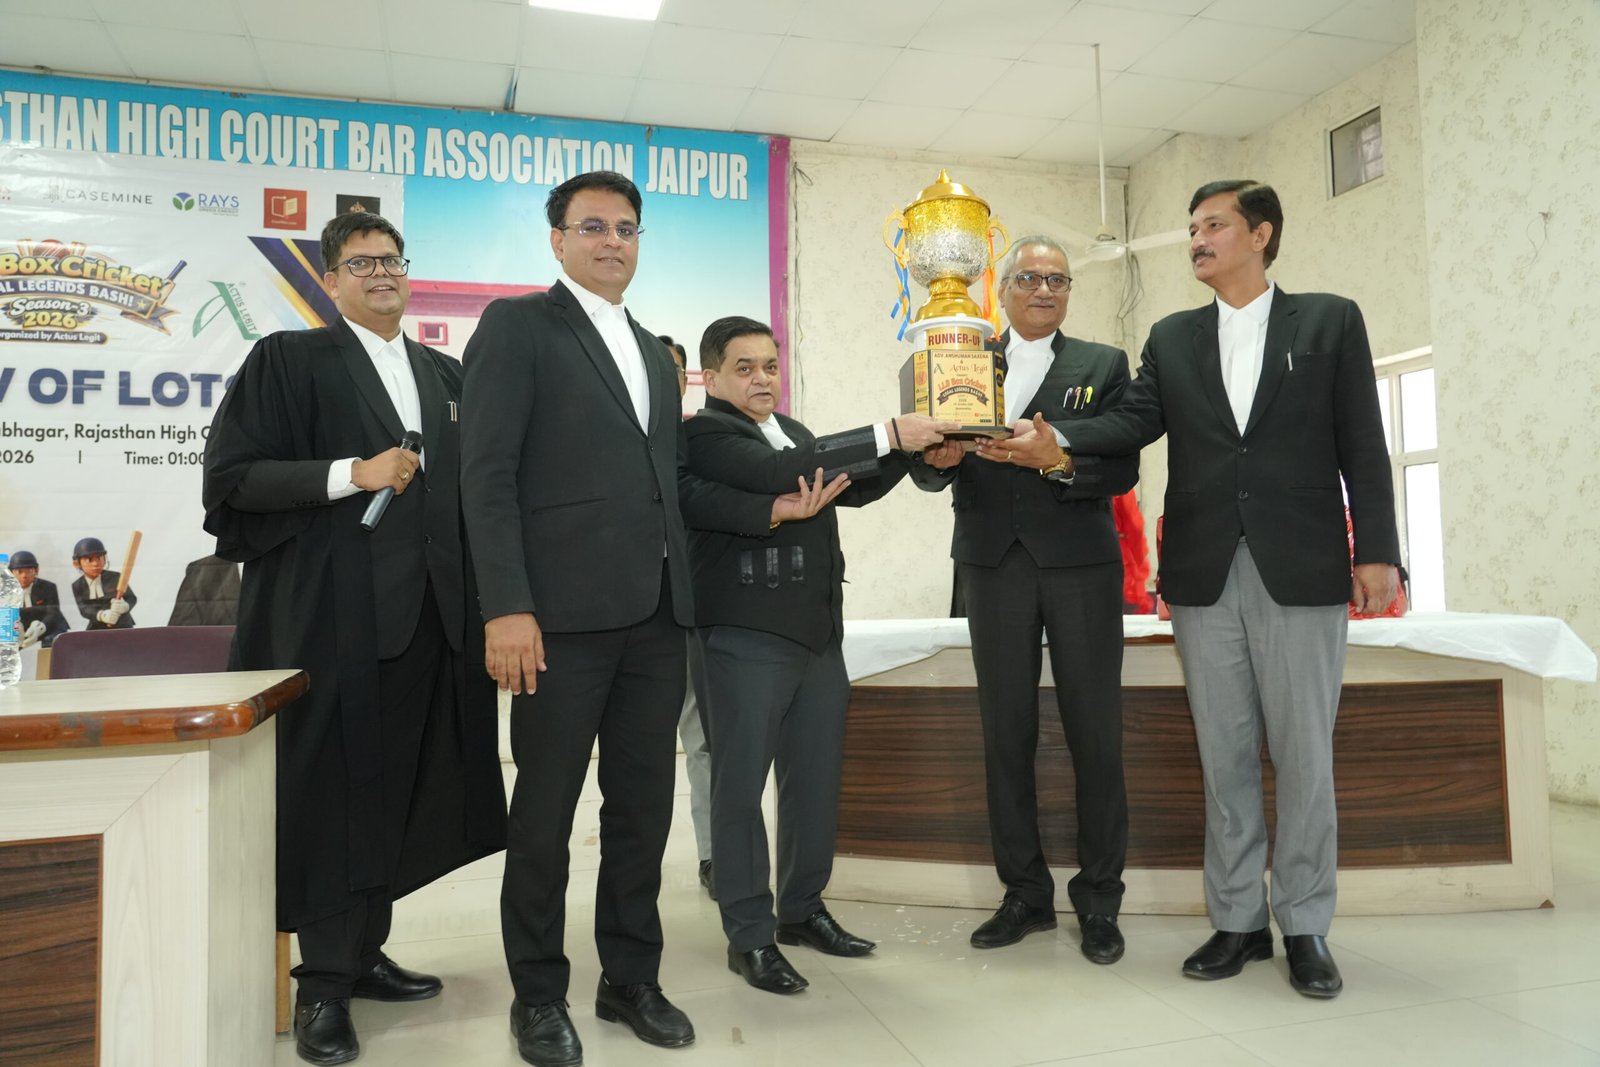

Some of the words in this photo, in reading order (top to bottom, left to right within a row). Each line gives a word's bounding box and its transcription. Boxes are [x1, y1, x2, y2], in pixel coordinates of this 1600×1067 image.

[0, 90, 107, 152] THAN
[117, 101, 210, 159] HIGH
[219, 109, 340, 169] COURT
[347, 120, 416, 176] BAR
[423, 127, 634, 185] ASSOCIATION
[645, 145, 748, 200] JAIPUR
[66, 189, 153, 204] CASEMINE
[198, 193, 239, 208] RAYS
[0, 253, 57, 275] Box
[60, 255, 164, 299] Cricket
[18, 280, 85, 295] LEGENDS
[89, 285, 134, 308] BASH!
[9, 298, 90, 317] Season-3
[227, 283, 245, 307] ACTUS
[240, 308, 257, 331] LEGIT
[23, 311, 77, 329] 2026
[41, 332, 53, 341] by
[53, 332, 77, 340] Actus
[79, 334, 101, 342] Legit
[28, 368, 105, 405] OF
[0, 421, 69, 442] bhagar,
[74, 423, 156, 443] Rajasthan
[160, 425, 197, 444] High
[0, 450, 34, 464] 026
[124, 451, 163, 464] Time:
